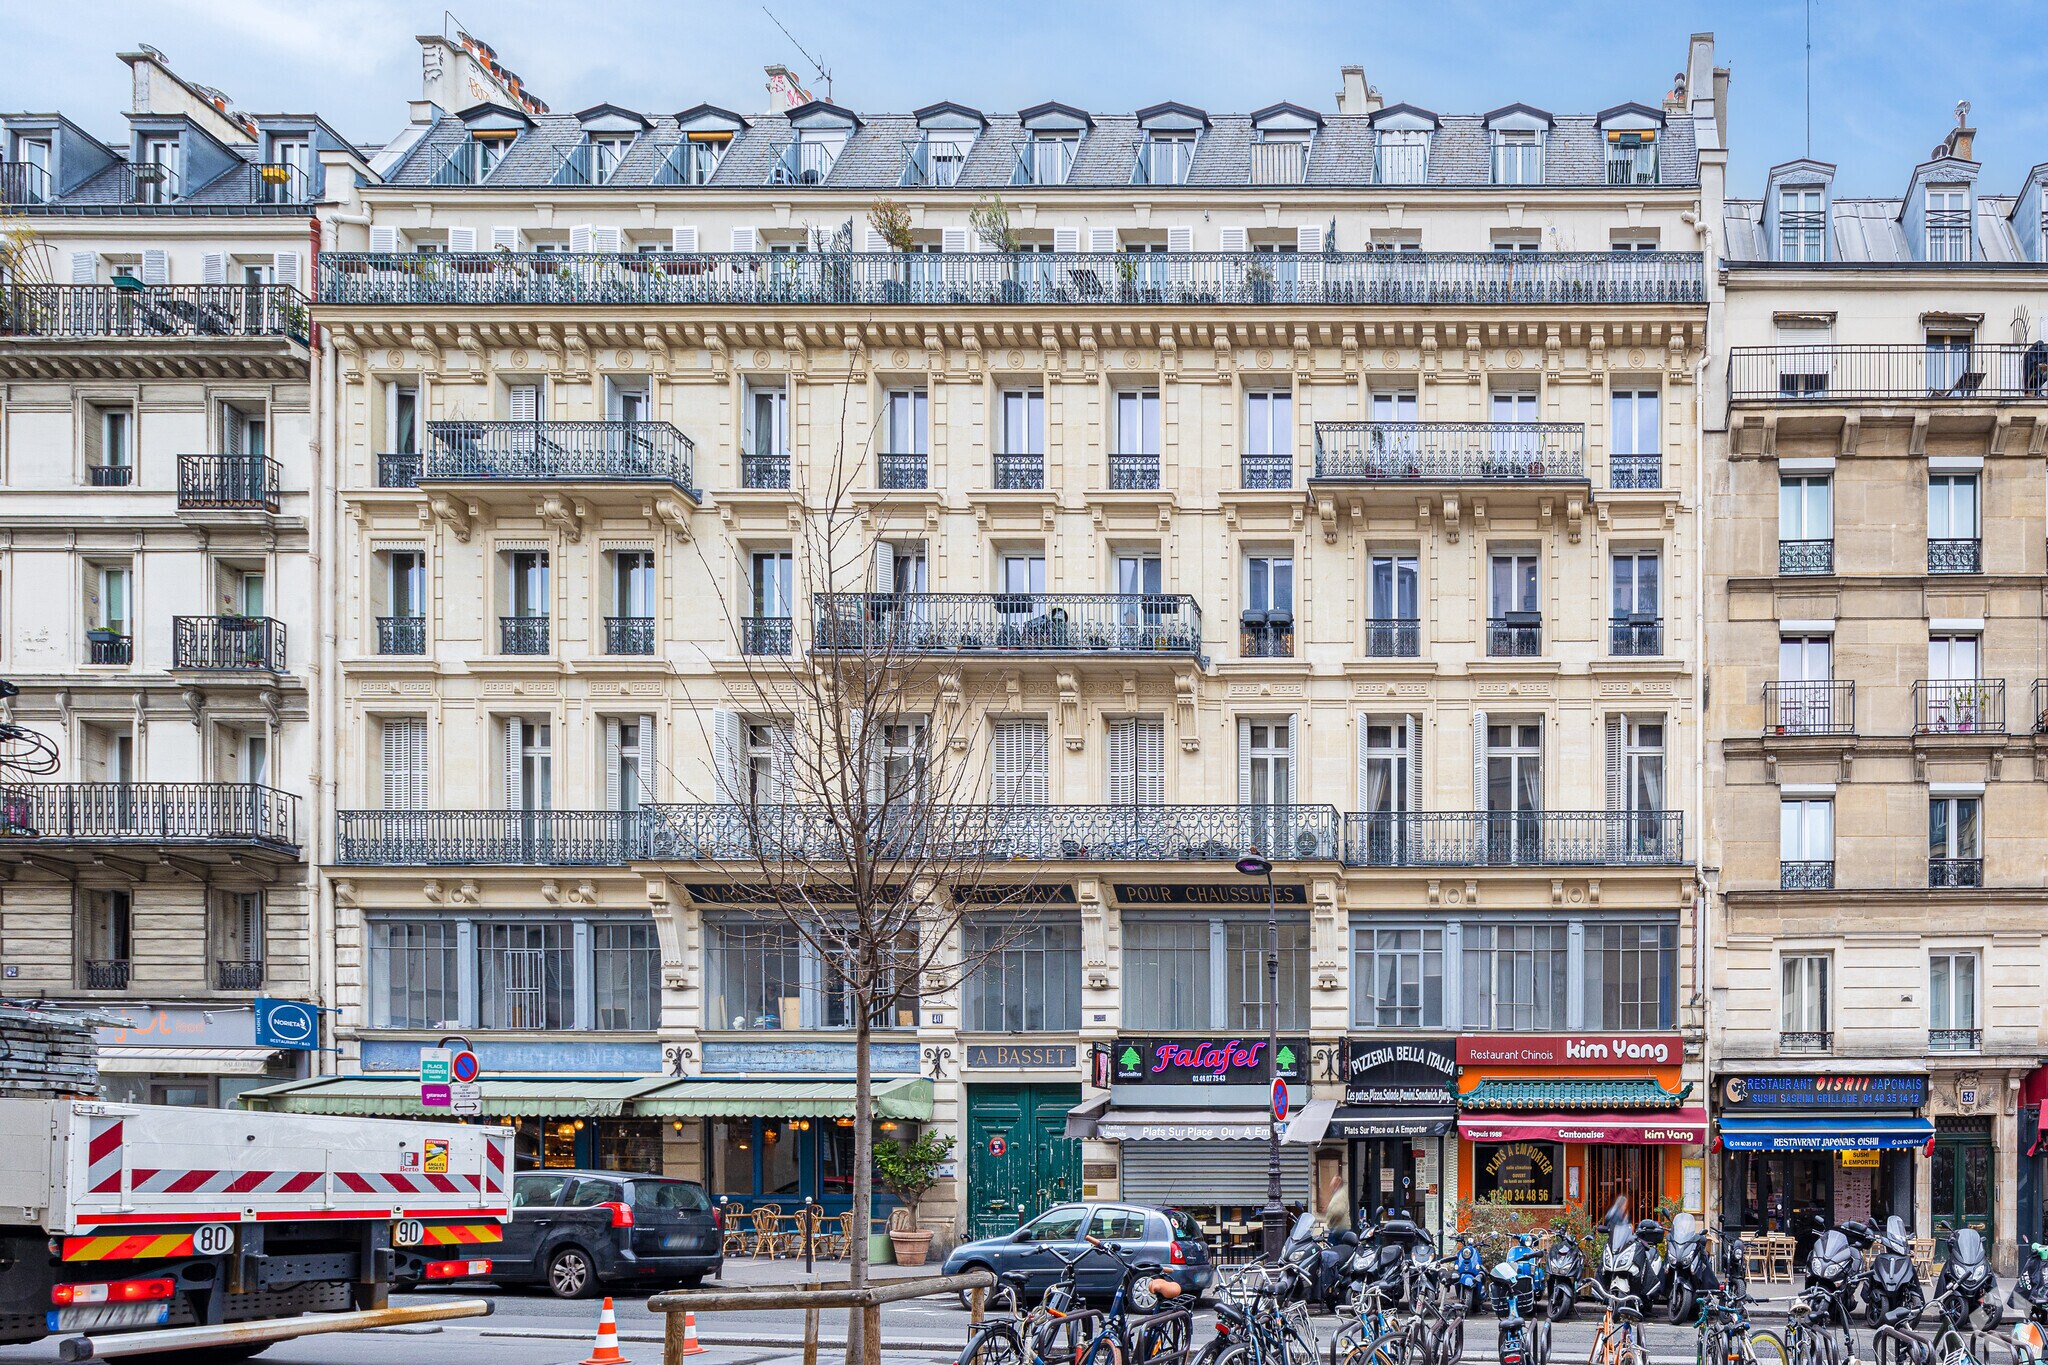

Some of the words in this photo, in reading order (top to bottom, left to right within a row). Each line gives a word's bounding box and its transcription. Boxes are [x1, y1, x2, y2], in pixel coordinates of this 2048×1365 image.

[1126, 886, 1173, 902] POUR
[1185, 886, 1295, 902] CHAUSSURES
[273, 1018, 303, 1028] NORIETA
[933, 1014, 942, 1024] 40
[997, 1046, 1067, 1065] BASSET
[1151, 1039, 1268, 1075] Falafel
[1470, 1049, 1519, 1060] Restaurant
[1520, 1049, 1554, 1060] Chinois
[1612, 1039, 1669, 1063] Yang
[1351, 1046, 1395, 1075] PIZZERIA
[1396, 1045, 1425, 1064] BELLA
[1426, 1050, 1455, 1077] ITALIA
[1747, 1078, 1813, 1090] RESTAURANT
[1816, 1076, 1870, 1091] OISHII
[1871, 1078, 1922, 1090] JAPONAIS
[1752, 1093, 1777, 1103] SUSHI
[1780, 1093, 1814, 1103] SASHIMI
[1817, 1093, 1858, 1103] GRILLADE
[1863, 1093, 1872, 1103] 01
[1886, 1093, 1897, 1103] 35
[1899, 1093, 1908, 1103] 14
[1910, 1093, 1919, 1103] 12
[1963, 1091, 1974, 1103] 38
[1142, 1126, 1166, 1137] Plats
[1168, 1126, 1185, 1137] Sur
[1187, 1126, 1213, 1137] Place
[1220, 1126, 1235, 1137] Ou
[1243, 1127, 1251, 1136] A
[1344, 1126, 1359, 1135] Plats
[1359, 1125, 1369, 1135] Sur
[1370, 1125, 1386, 1135] Place
[1386, 1126, 1395, 1134] ou
[1395, 1125, 1400, 1134] A
[1400, 1125, 1428, 1136] Emporter
[1467, 1130, 1489, 1138] Depuis
[1558, 1129, 1605, 1139] Cantonaises
[1666, 1129, 1694, 1141] Yang
[1821, 1137, 1856, 1147] JAPONAIS
[1857, 1136, 1879, 1146] OISHII
[1485, 1148, 1507, 1176] PLATS
[1515, 1143, 1553, 1176] EMPORTER
[1503, 1189, 1513, 1202] 40
[1514, 1189, 1525, 1202] 34
[1526, 1189, 1537, 1202] 48
[1538, 1189, 1549, 1202] 56
[399, 1220, 419, 1243] 90
[201, 1226, 227, 1251] 80
